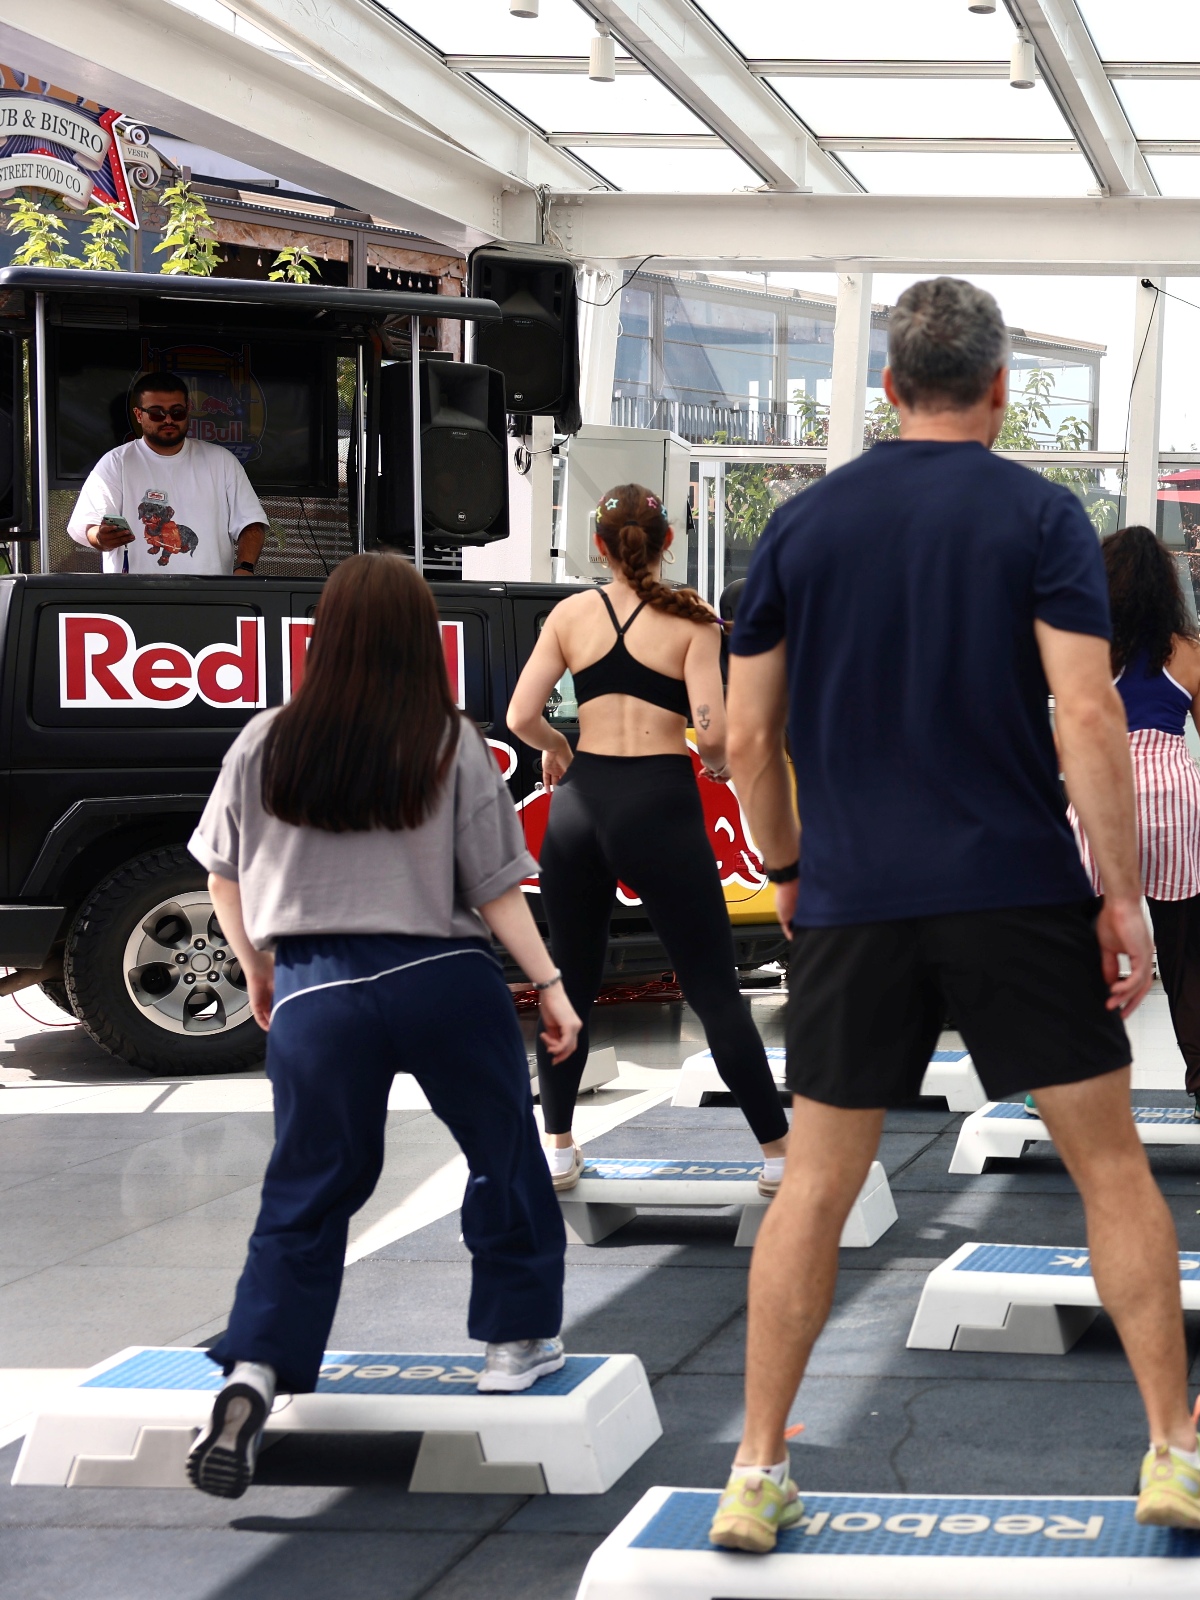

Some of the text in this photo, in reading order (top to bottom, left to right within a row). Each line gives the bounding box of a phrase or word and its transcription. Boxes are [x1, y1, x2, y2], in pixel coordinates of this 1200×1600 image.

[22, 109, 36, 128] &
[40, 112, 103, 153] BISTRO
[0, 163, 84, 196] STREET FOOD CO.
[202, 421, 243, 442] Bull
[59, 613, 266, 709] Red
[785, 1511, 1105, 1541] Reebok
